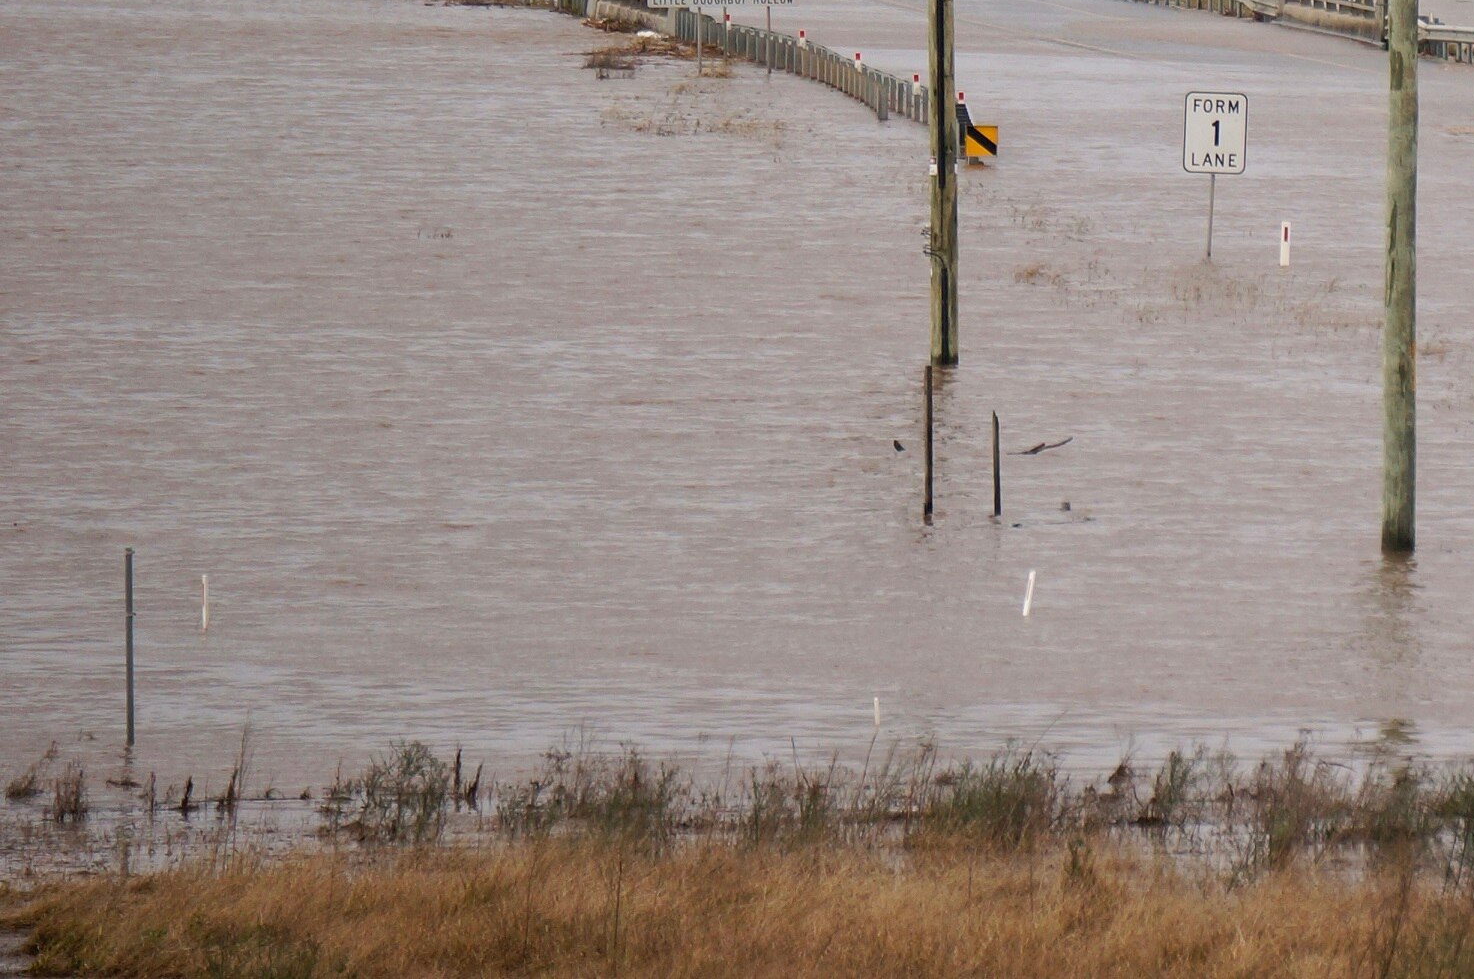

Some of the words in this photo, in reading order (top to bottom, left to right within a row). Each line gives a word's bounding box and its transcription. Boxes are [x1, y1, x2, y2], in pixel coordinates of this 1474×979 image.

[1193, 99, 1240, 114] FORM
[1211, 120, 1220, 147] 1
[1191, 152, 1238, 168] LANE
